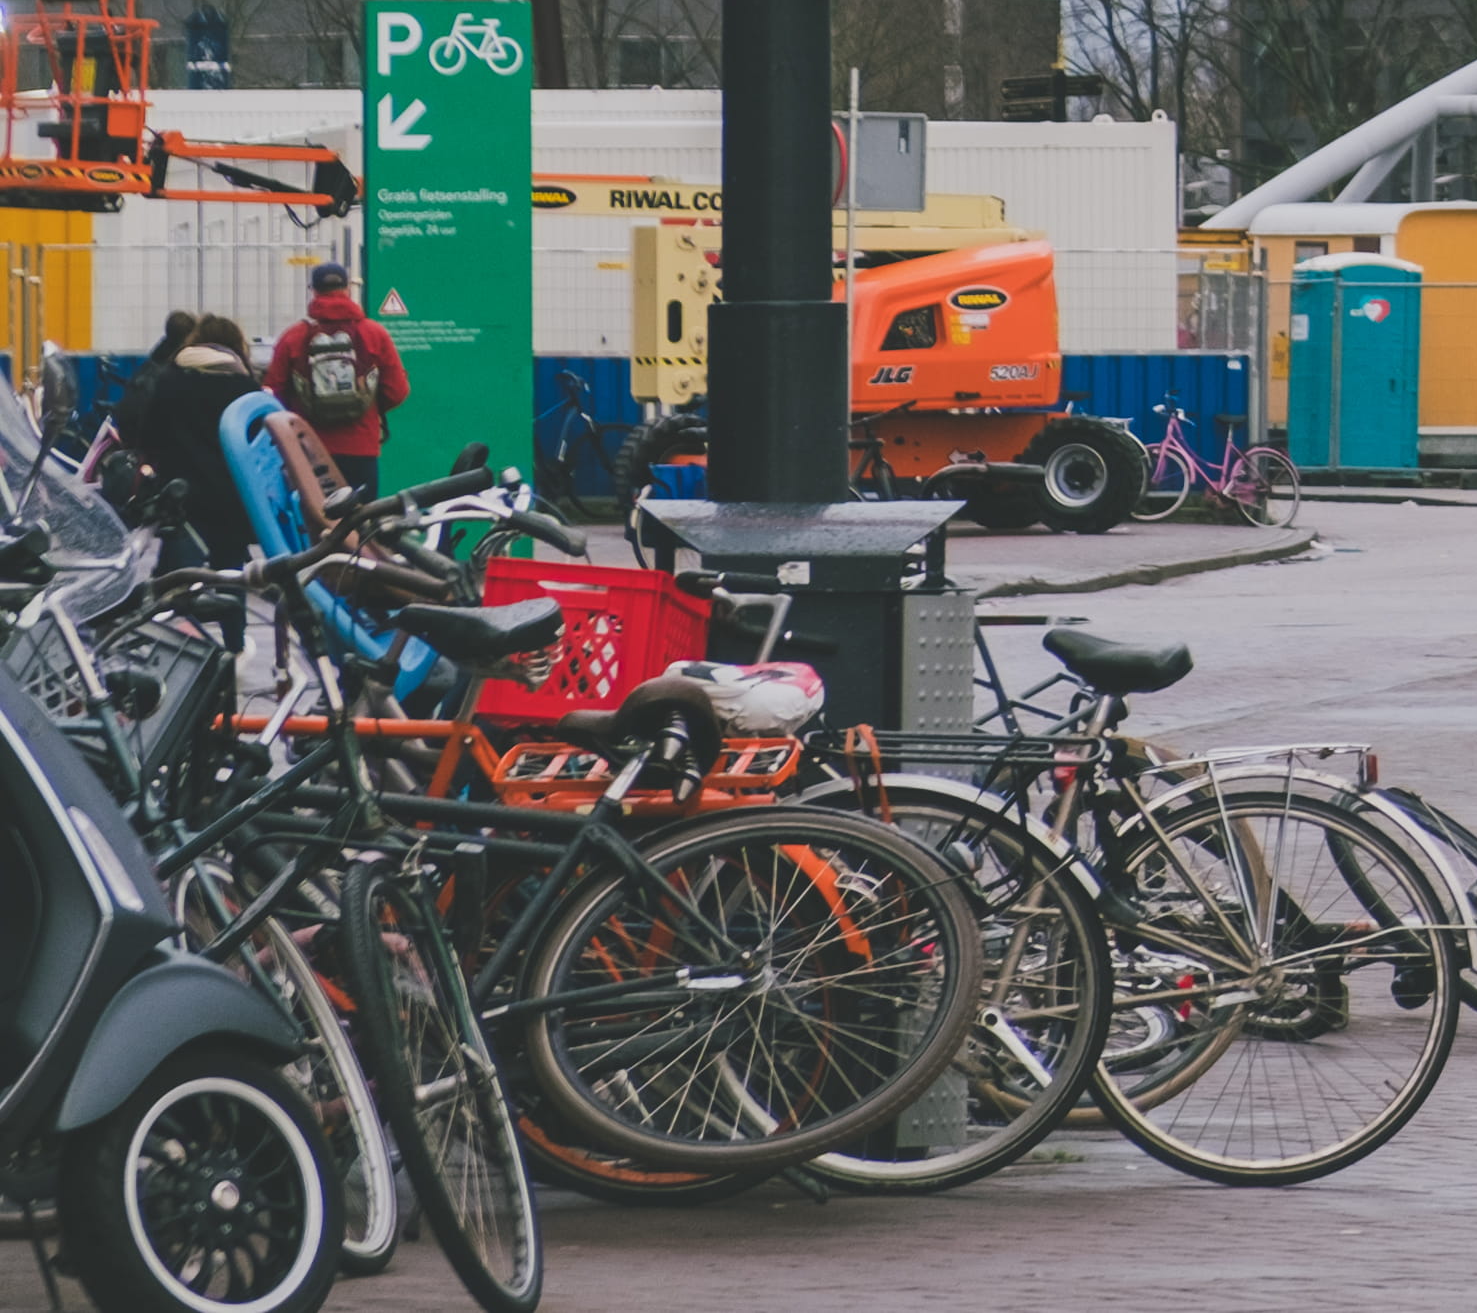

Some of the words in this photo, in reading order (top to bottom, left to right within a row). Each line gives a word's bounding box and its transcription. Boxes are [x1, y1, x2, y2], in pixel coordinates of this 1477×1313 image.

[376, 11, 423, 76] P
[377, 188, 417, 203] Gratis
[419, 187, 508, 205] fietsenstalling
[609, 189, 722, 211] RIWAL.CO
[957, 293, 1002, 306] RIWAL
[869, 366, 913, 384] JLG
[989, 365, 1039, 381] 520AJ
